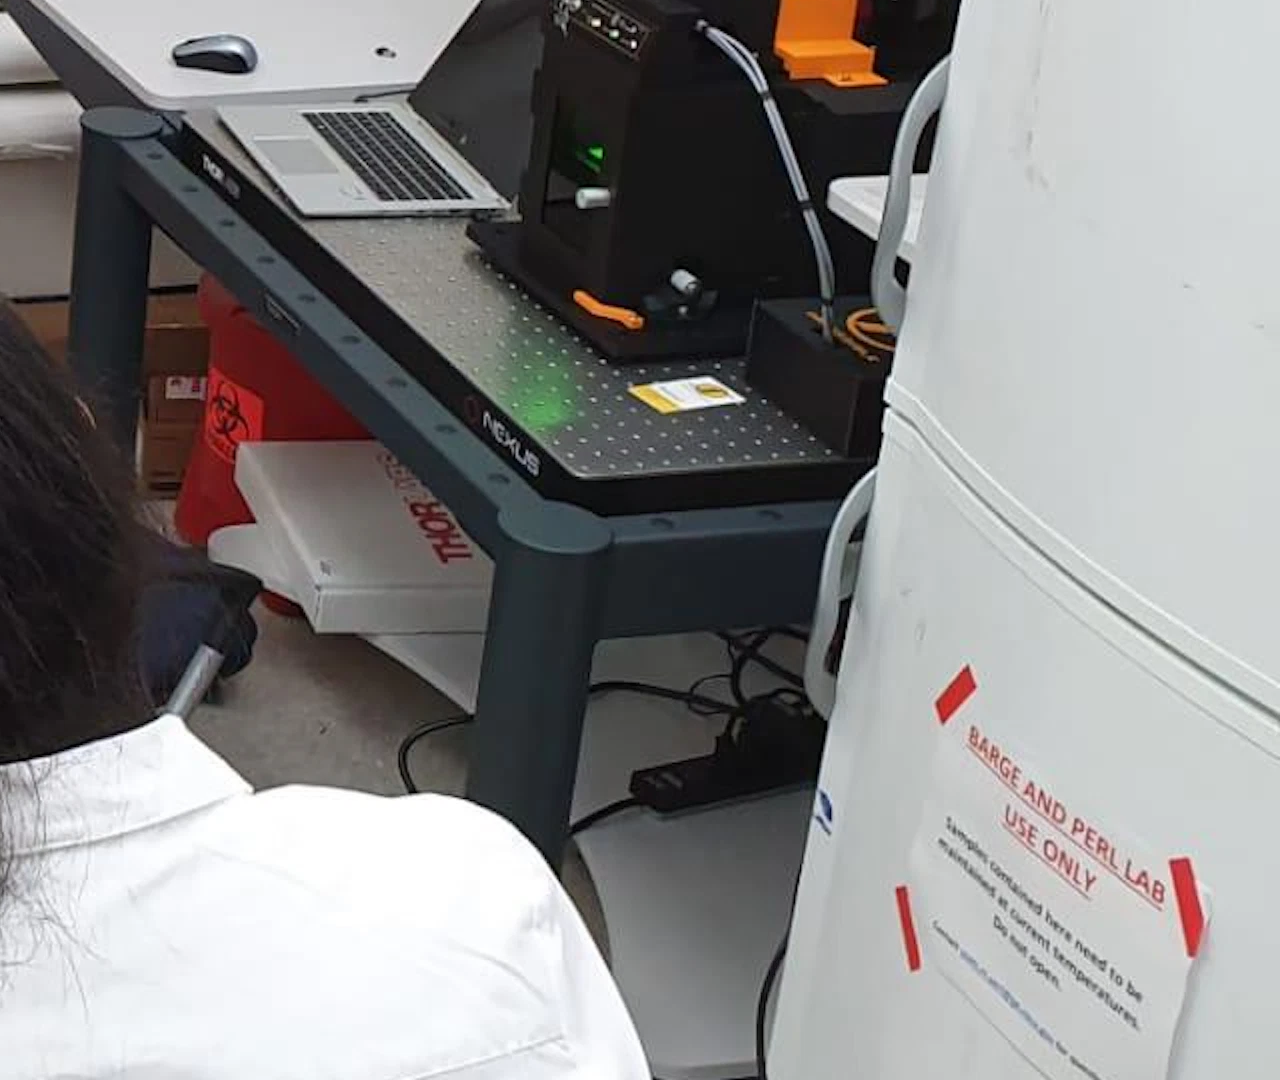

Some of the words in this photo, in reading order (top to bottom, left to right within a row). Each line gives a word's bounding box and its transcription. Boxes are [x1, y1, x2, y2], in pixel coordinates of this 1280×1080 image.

[482, 410, 540, 477] NEXUS
[968, 724, 1022, 789] BARGE
[1023, 780, 1067, 825] AND
[1071, 817, 1118, 870] PERL
[1124, 858, 1166, 904] LAB
[1005, 804, 1038, 848] USE
[1043, 839, 1097, 892] ONLY
[938, 837, 996, 898] maintained
[998, 896, 1009, 912] at
[1010, 908, 1051, 953] current
[1053, 945, 1140, 1032] temperatures.
[946, 816, 988, 864] Samples
[989, 860, 1043, 916] contained
[1045, 909, 1072, 942] here
[1075, 939, 1108, 972] need
[1110, 967, 1124, 987] to
[1126, 980, 1142, 1003] be
[993, 914, 1009, 938] Do
[1009, 933, 1028, 958] not
[1030, 954, 1062, 992] open.
